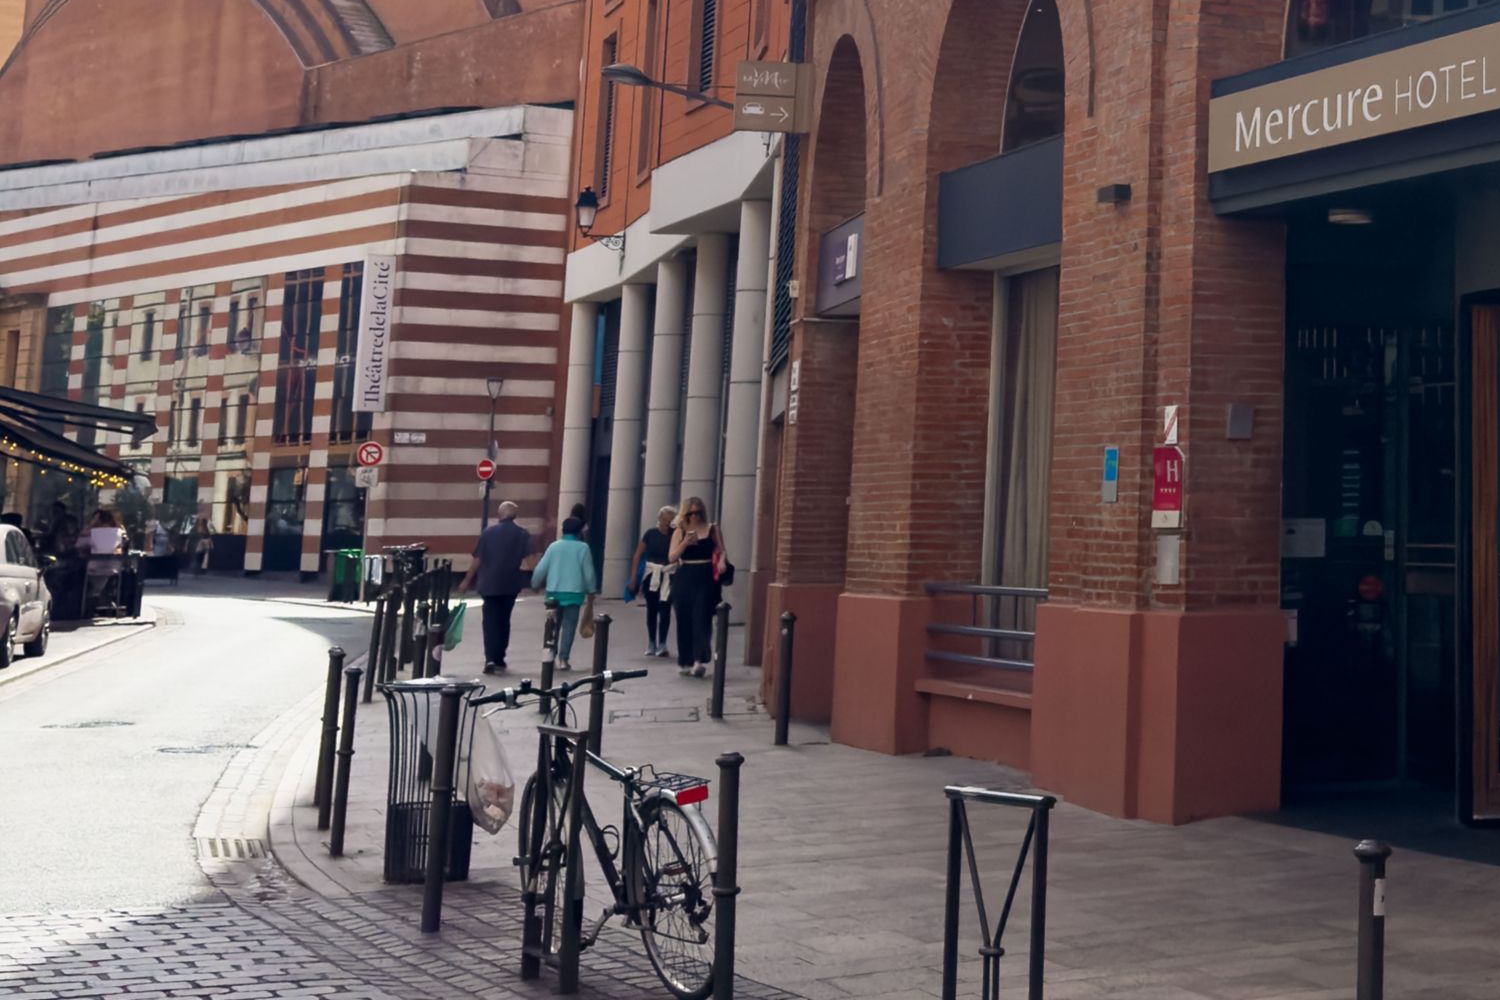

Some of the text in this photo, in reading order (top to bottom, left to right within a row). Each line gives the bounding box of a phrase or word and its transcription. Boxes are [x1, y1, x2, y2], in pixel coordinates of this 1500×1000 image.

[1234, 56, 1497, 153] Mercure HOTEL
[1166, 460, 1179, 482] H
